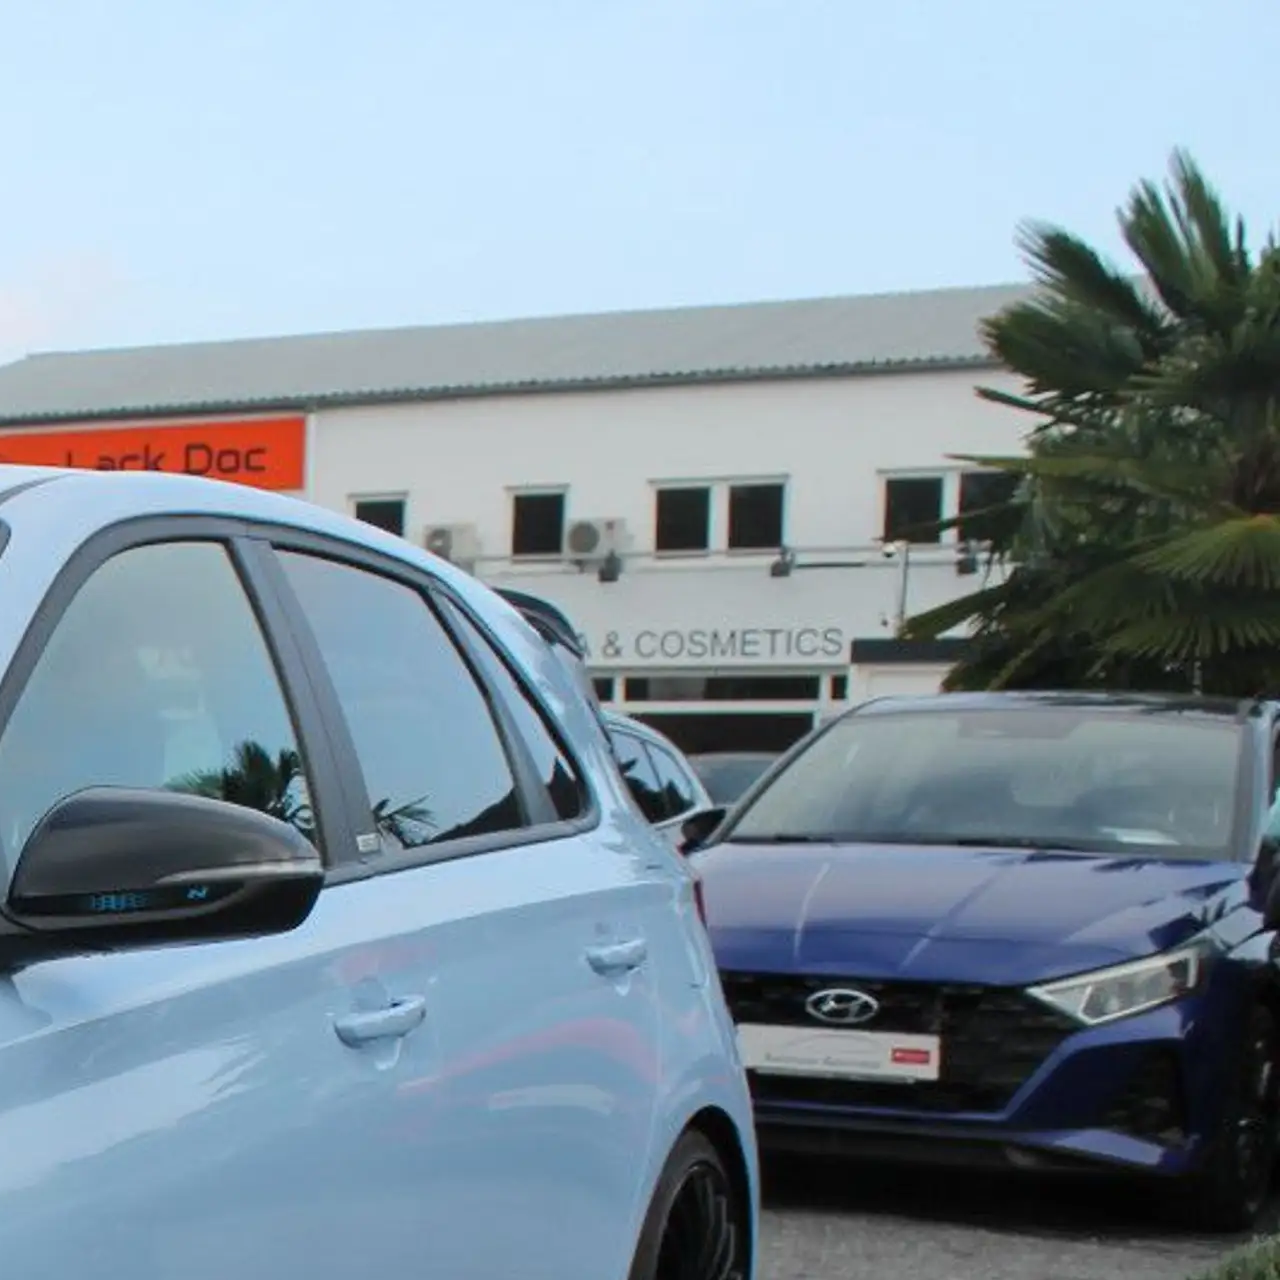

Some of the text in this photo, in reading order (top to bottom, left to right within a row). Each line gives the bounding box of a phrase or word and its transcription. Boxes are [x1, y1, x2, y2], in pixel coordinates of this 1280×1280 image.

[185, 443, 267, 475] Doc
[603, 630, 622, 658] &
[634, 627, 844, 659] COSMETICS
